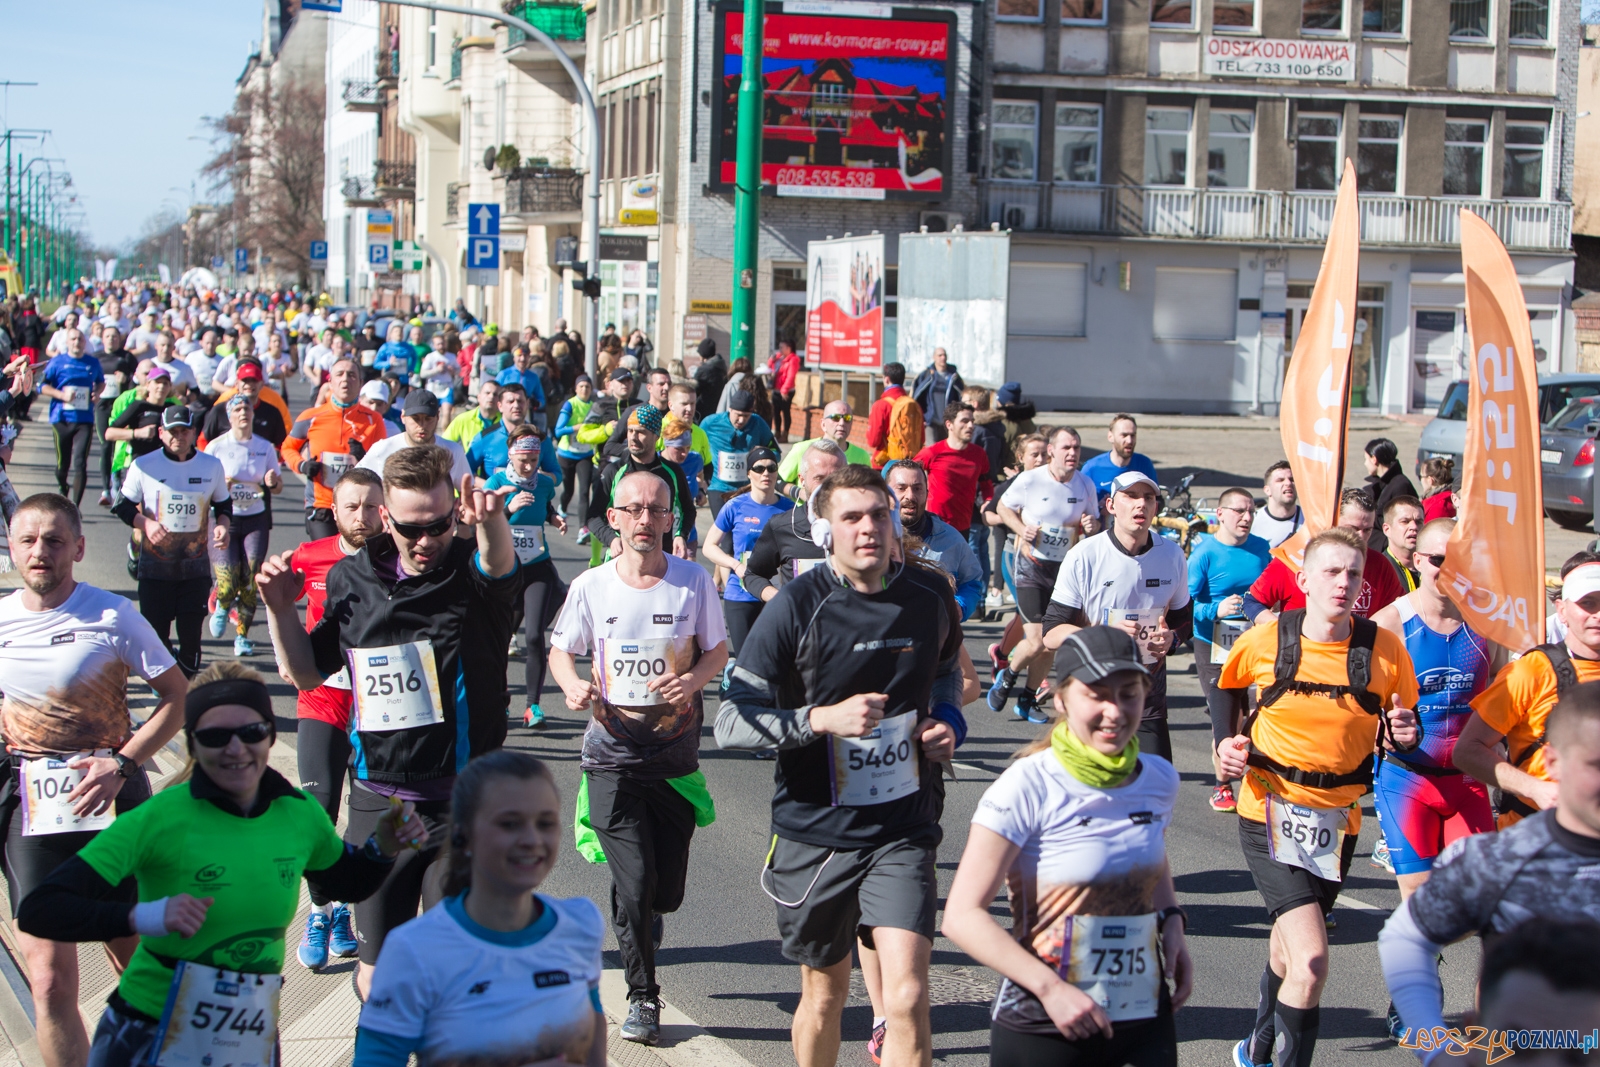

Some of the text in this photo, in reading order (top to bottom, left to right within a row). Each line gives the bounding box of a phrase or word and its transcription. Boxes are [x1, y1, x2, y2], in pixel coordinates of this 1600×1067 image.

[788, 31, 945, 55] www.kormoran-rowy.pl
[1208, 39, 1350, 61] ODSZKODOWANIA
[1216, 60, 1343, 76] TEL. 733 100 650
[776, 168, 876, 187] 608-535-538
[474, 239, 493, 265] P
[725, 461, 745, 470] 2261
[167, 503, 197, 515] 5918
[1042, 533, 1069, 547] 3279
[613, 658, 666, 677] 9700
[365, 670, 421, 696] 2516
[1423, 673, 1475, 686] Enea
[848, 740, 910, 771] 5460
[871, 769, 896, 779] Bartosz
[1281, 820, 1331, 848] 8510
[1091, 947, 1146, 975] 7315
[190, 1001, 265, 1035] 5744
